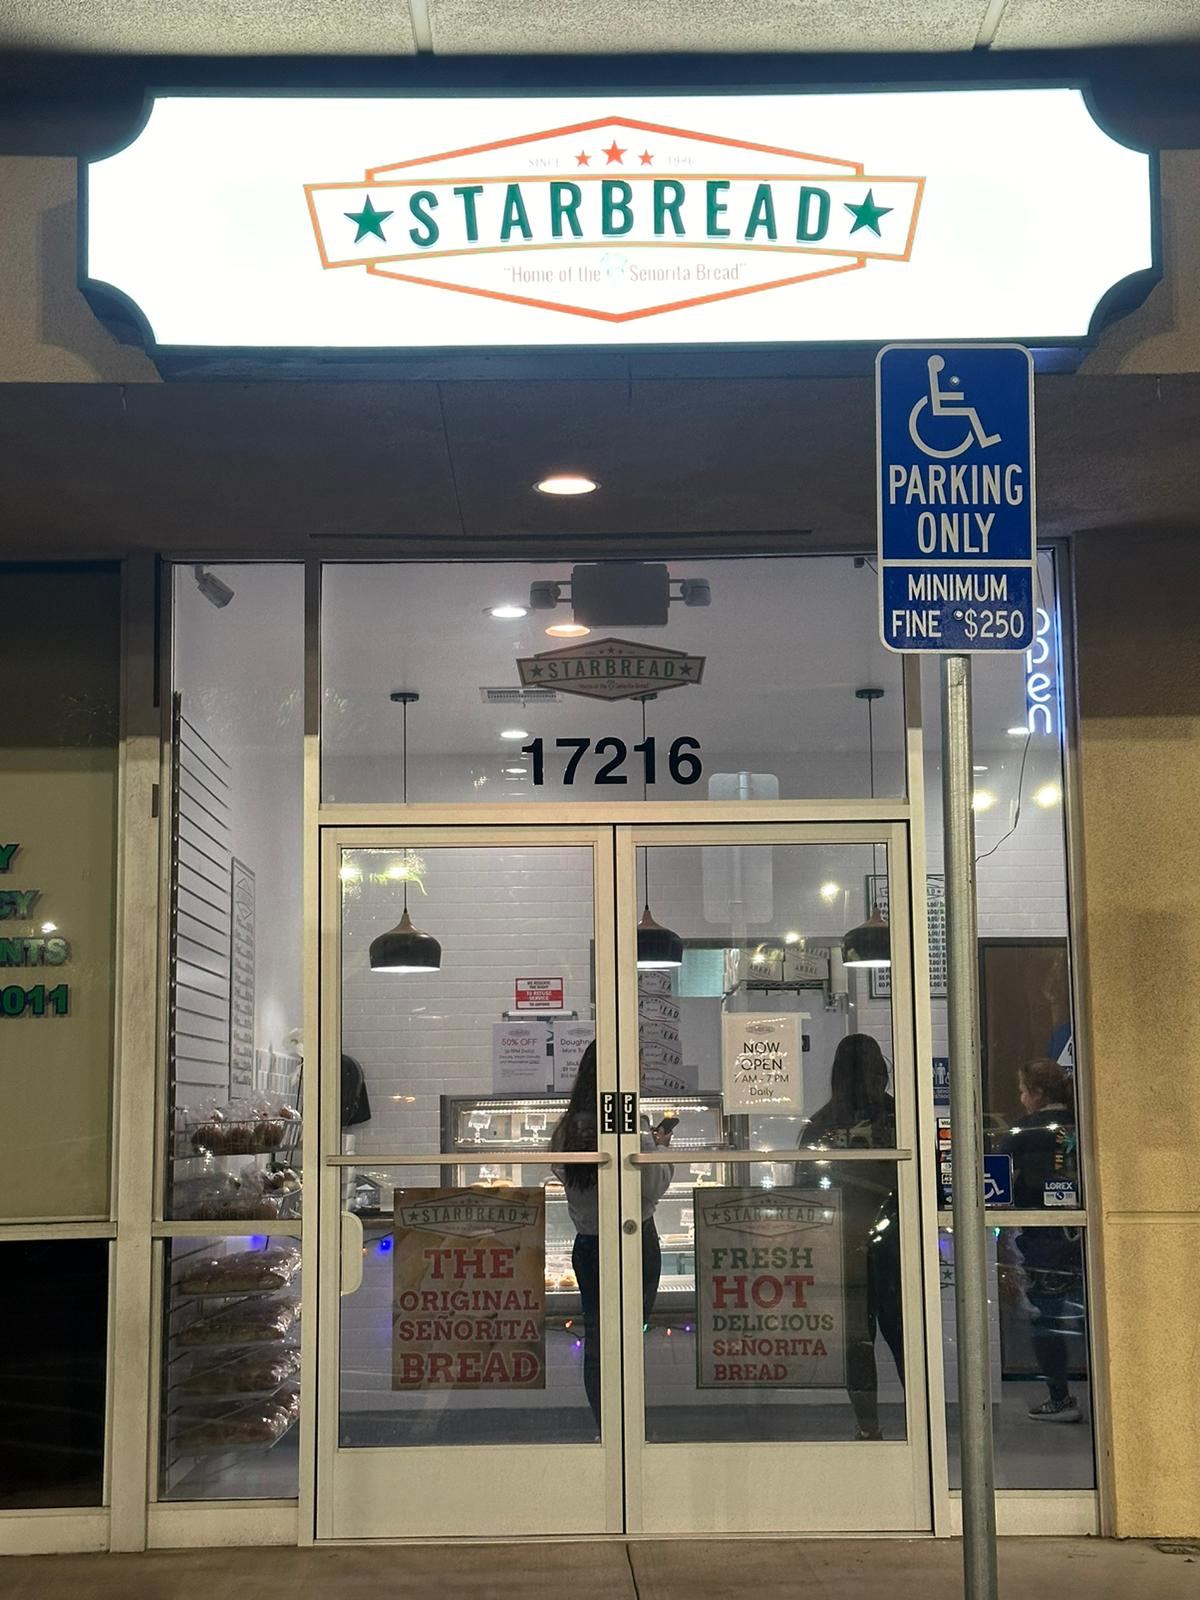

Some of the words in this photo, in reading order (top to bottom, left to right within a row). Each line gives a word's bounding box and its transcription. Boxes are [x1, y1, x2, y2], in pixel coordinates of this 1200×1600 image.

[408, 180, 831, 247] STARBREAD
[558, 265, 577, 282] of
[578, 264, 601, 282] the
[889, 464, 1024, 506] PARKING
[917, 512, 996, 554] ONLY
[908, 574, 1008, 602] MINIMUM
[892, 609, 942, 639] FINE
[964, 608, 1025, 639] $250
[548, 659, 675, 679] STARBREAD
[521, 737, 703, 786] 17216
[743, 1041, 780, 1054] NOW
[741, 1058, 783, 1071] OPEN
[742, 1074, 757, 1083] AM
[750, 1086, 774, 1097] Daily
[604, 1094, 613, 1132] PULL
[624, 1094, 633, 1132] PULL
[1045, 1181, 1073, 1191] LOREX
[422, 1207, 518, 1223] STARBREAD
[424, 1248, 514, 1280] THE
[712, 1247, 814, 1270] FRESH
[400, 1289, 540, 1312] ORIGINAL
[712, 1275, 815, 1309] HOT
[400, 1315, 539, 1342] SEÑORITA
[712, 1314, 834, 1332] DELICIOUS
[712, 1335, 828, 1357] SEÑORITA
[400, 1352, 539, 1384] BREAD
[713, 1363, 788, 1382] BREAD
